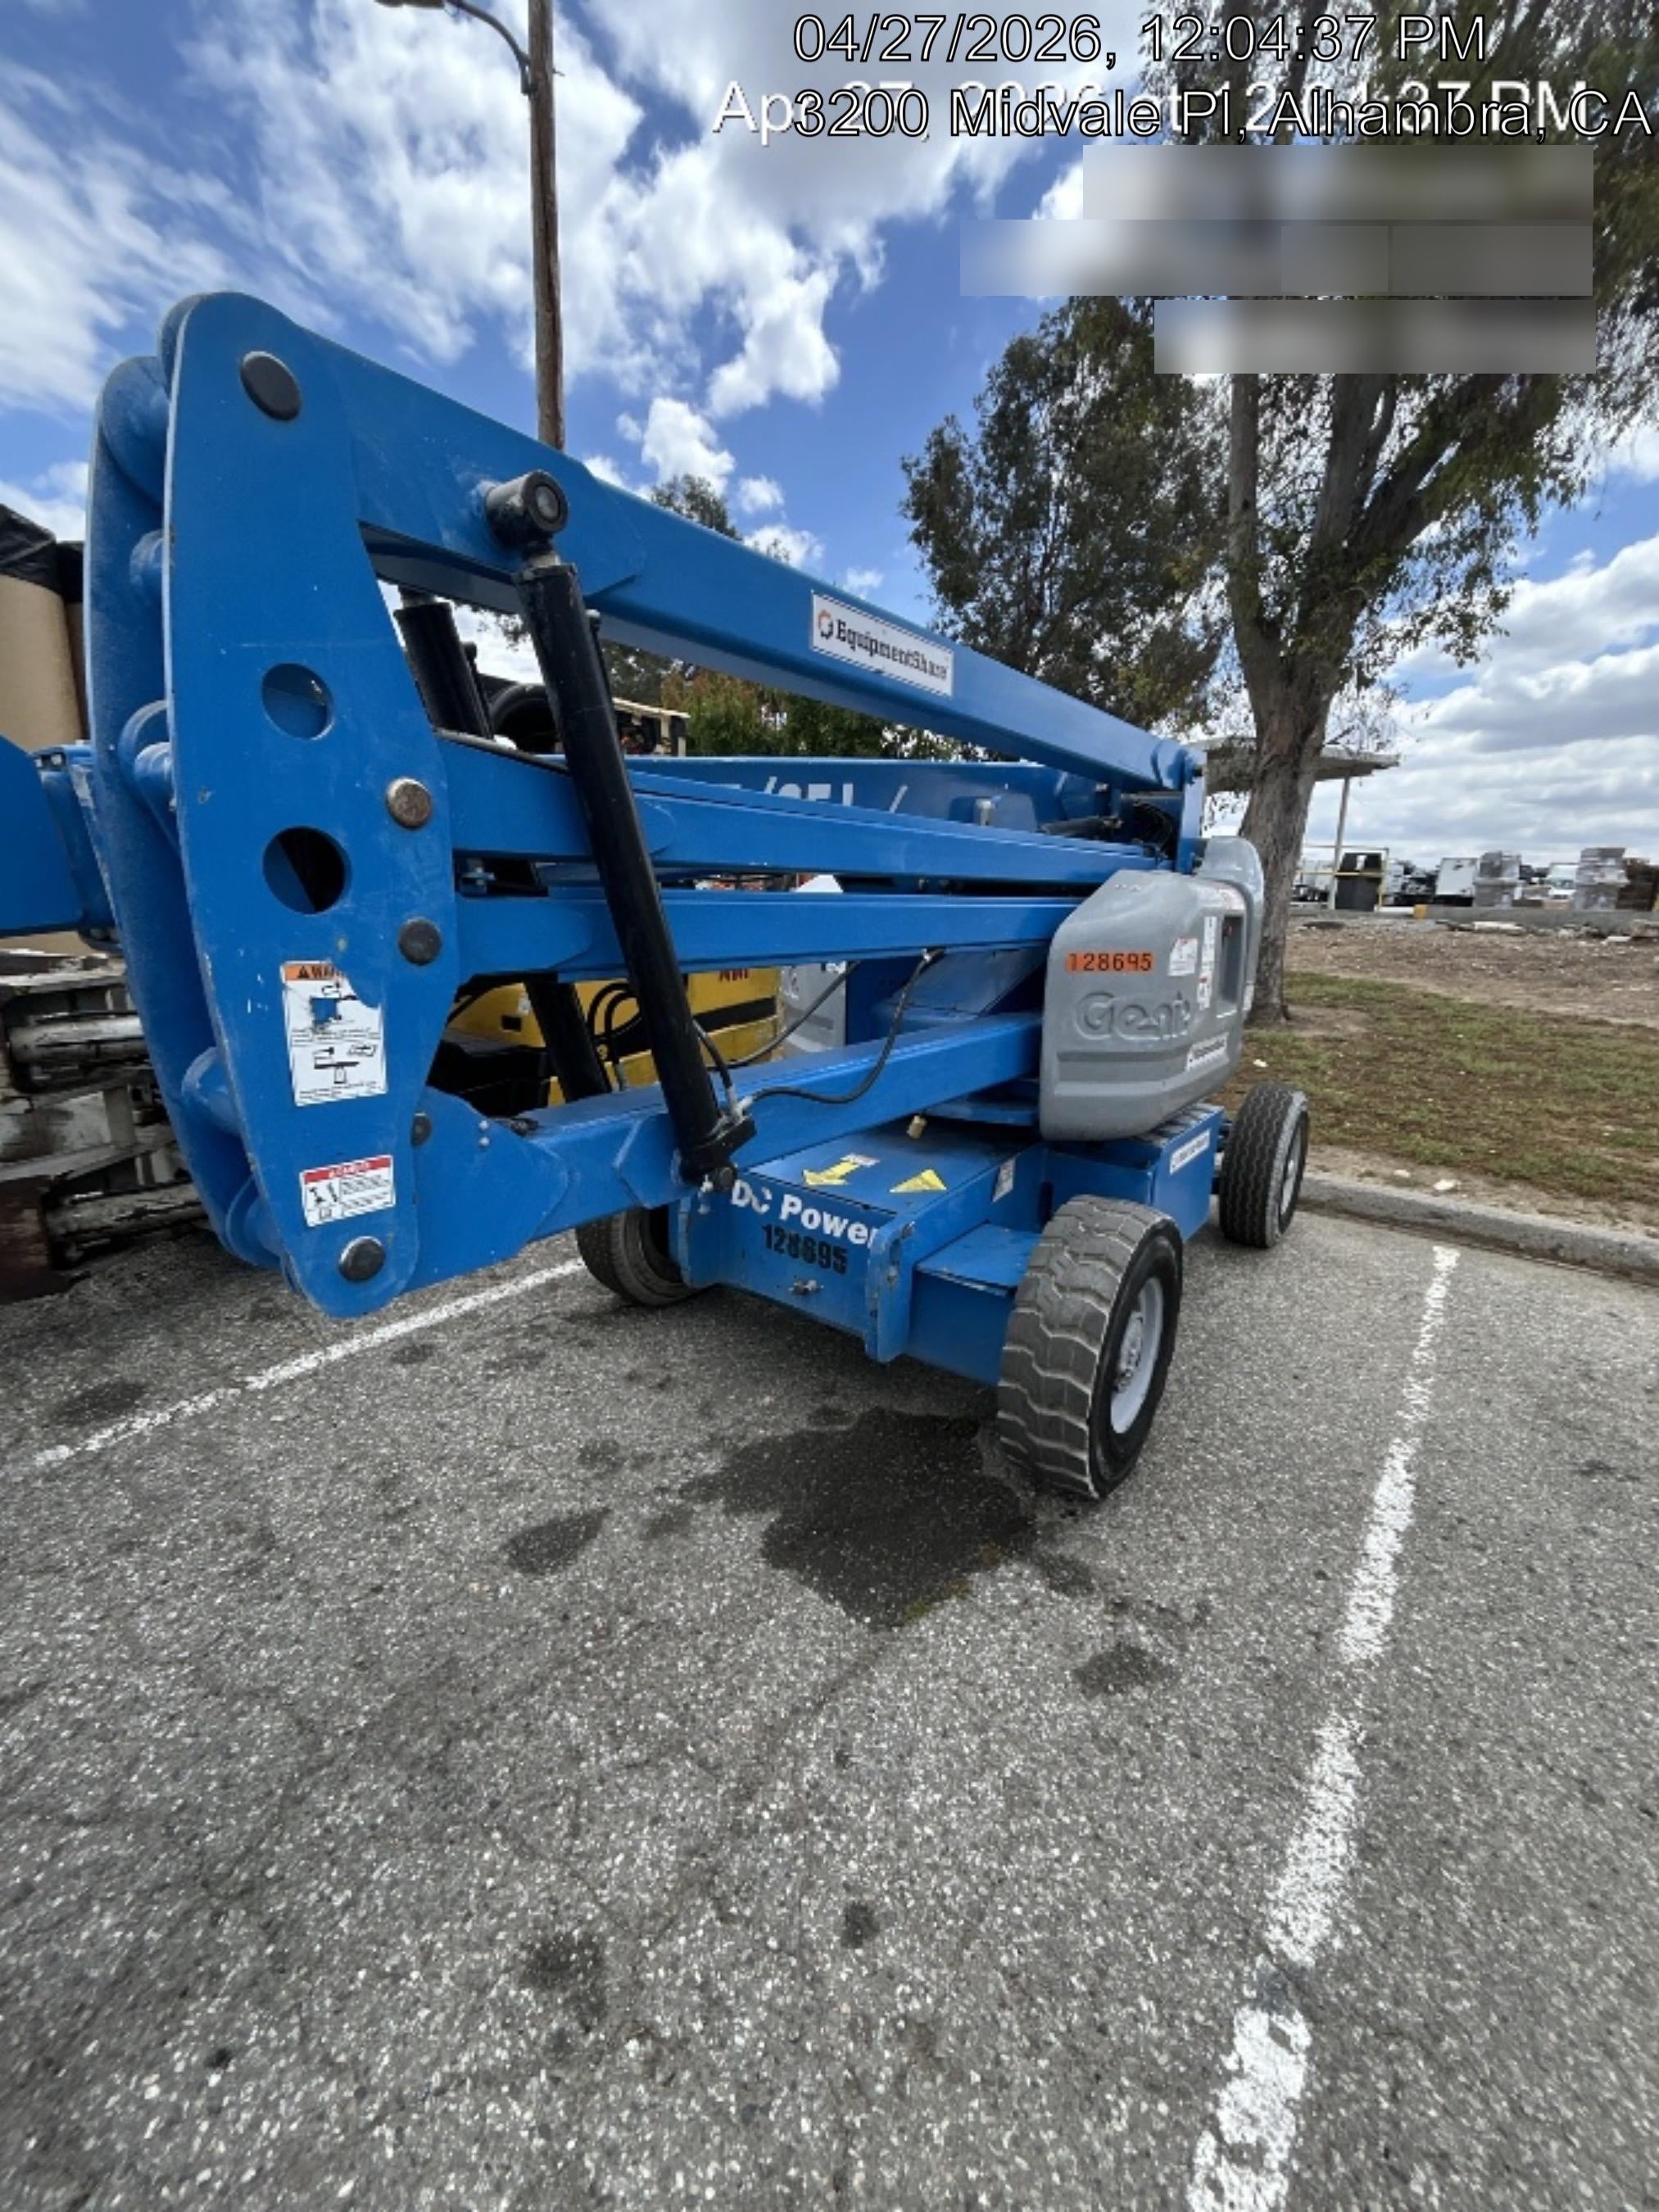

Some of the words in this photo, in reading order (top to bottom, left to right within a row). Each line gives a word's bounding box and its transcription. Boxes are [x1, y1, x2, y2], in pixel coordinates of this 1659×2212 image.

[836, 619, 948, 681] EquipmentShare
[1067, 952, 1154, 972] 128695
[731, 1178, 773, 1214] DC
[763, 1223, 848, 1274] 128695
